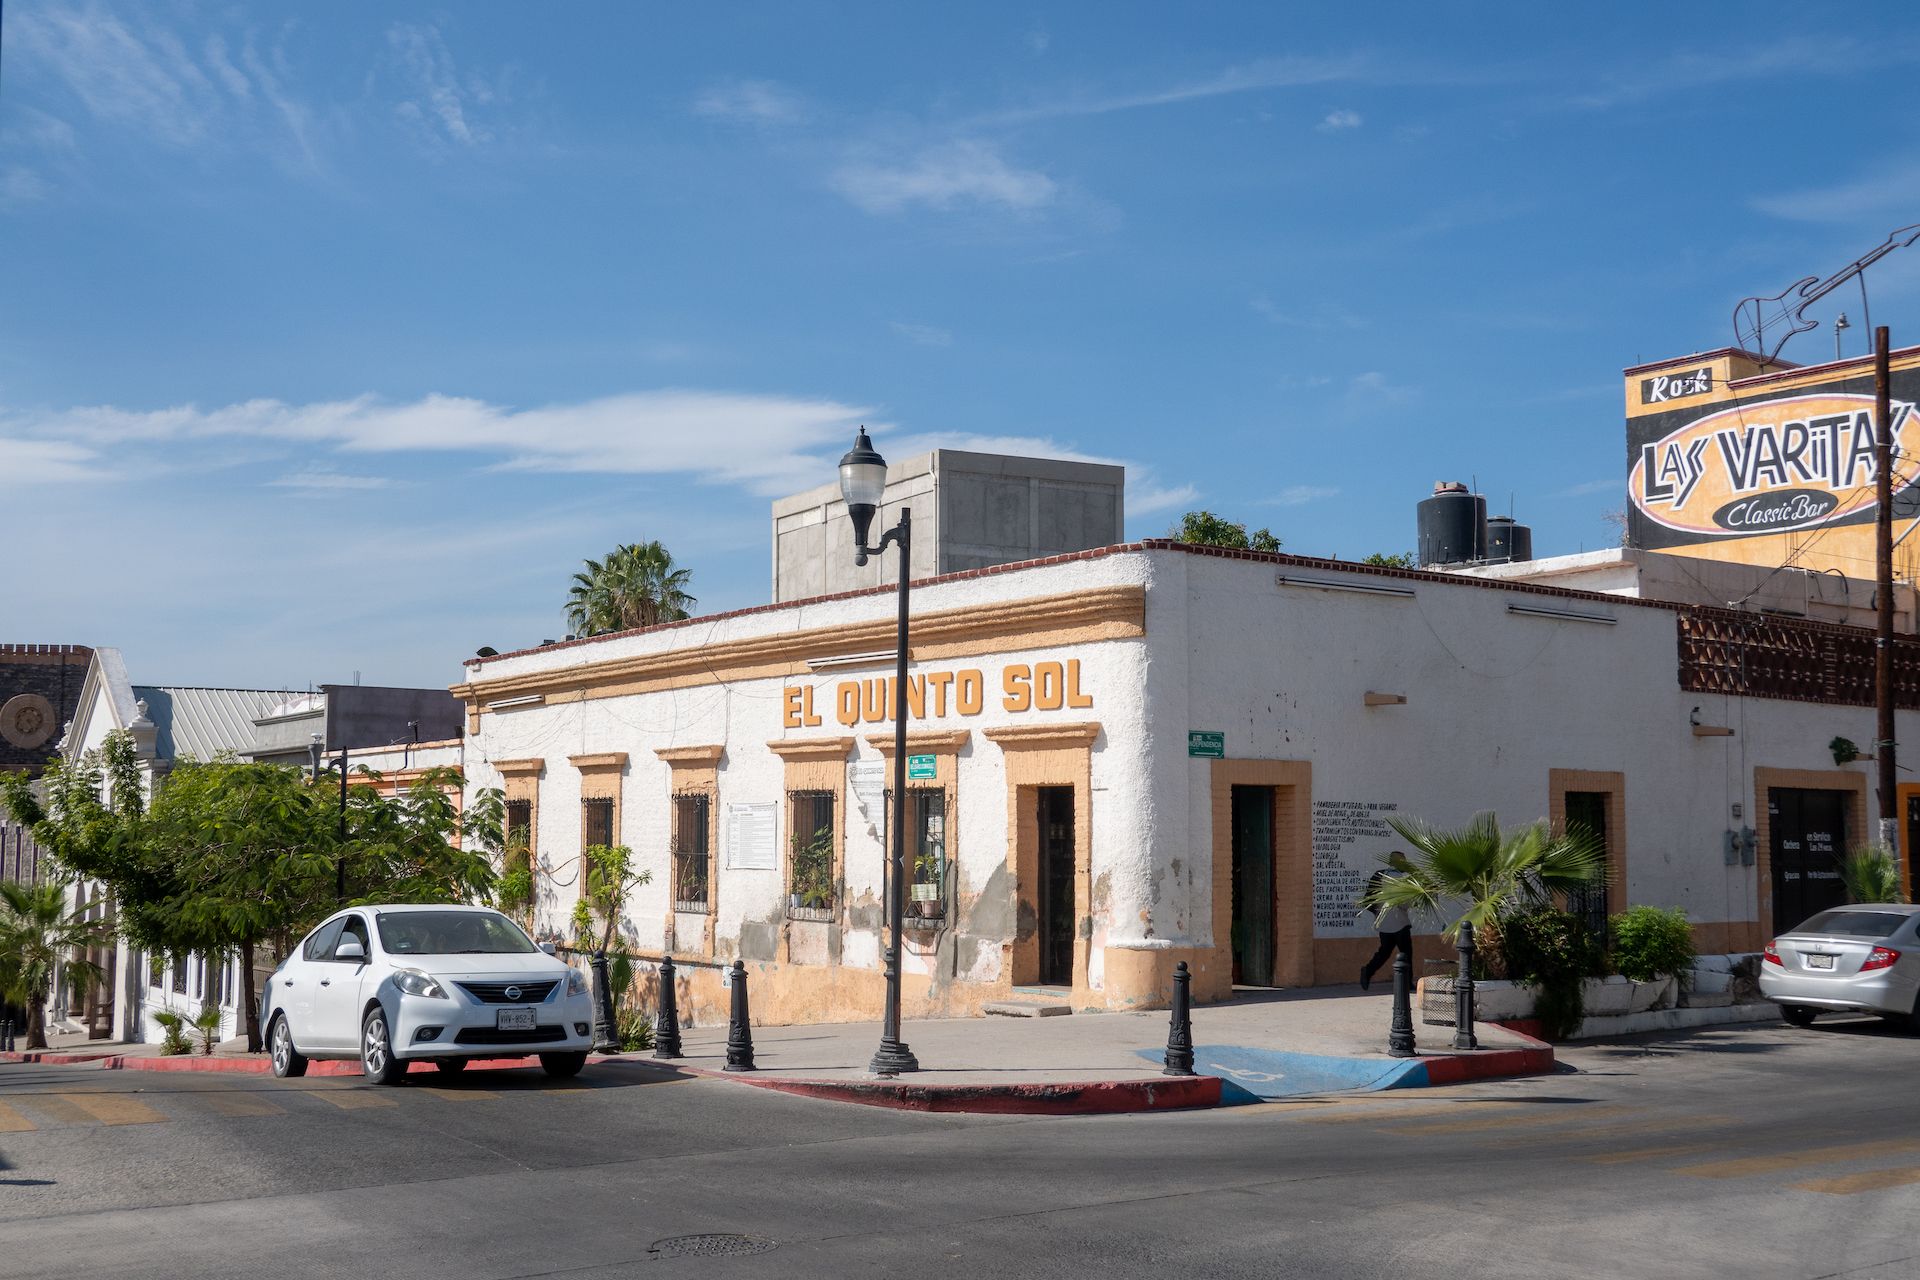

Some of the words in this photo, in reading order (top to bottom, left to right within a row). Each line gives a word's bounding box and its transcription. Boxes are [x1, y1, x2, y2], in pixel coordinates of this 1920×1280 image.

[1642, 436, 1711, 510] LAS
[1727, 501, 1791, 526] Classic
[1790, 494, 1829, 521] Bar
[783, 685, 822, 728] EL
[836, 669, 984, 727] QUINTO
[1002, 659, 1093, 712] SOL
